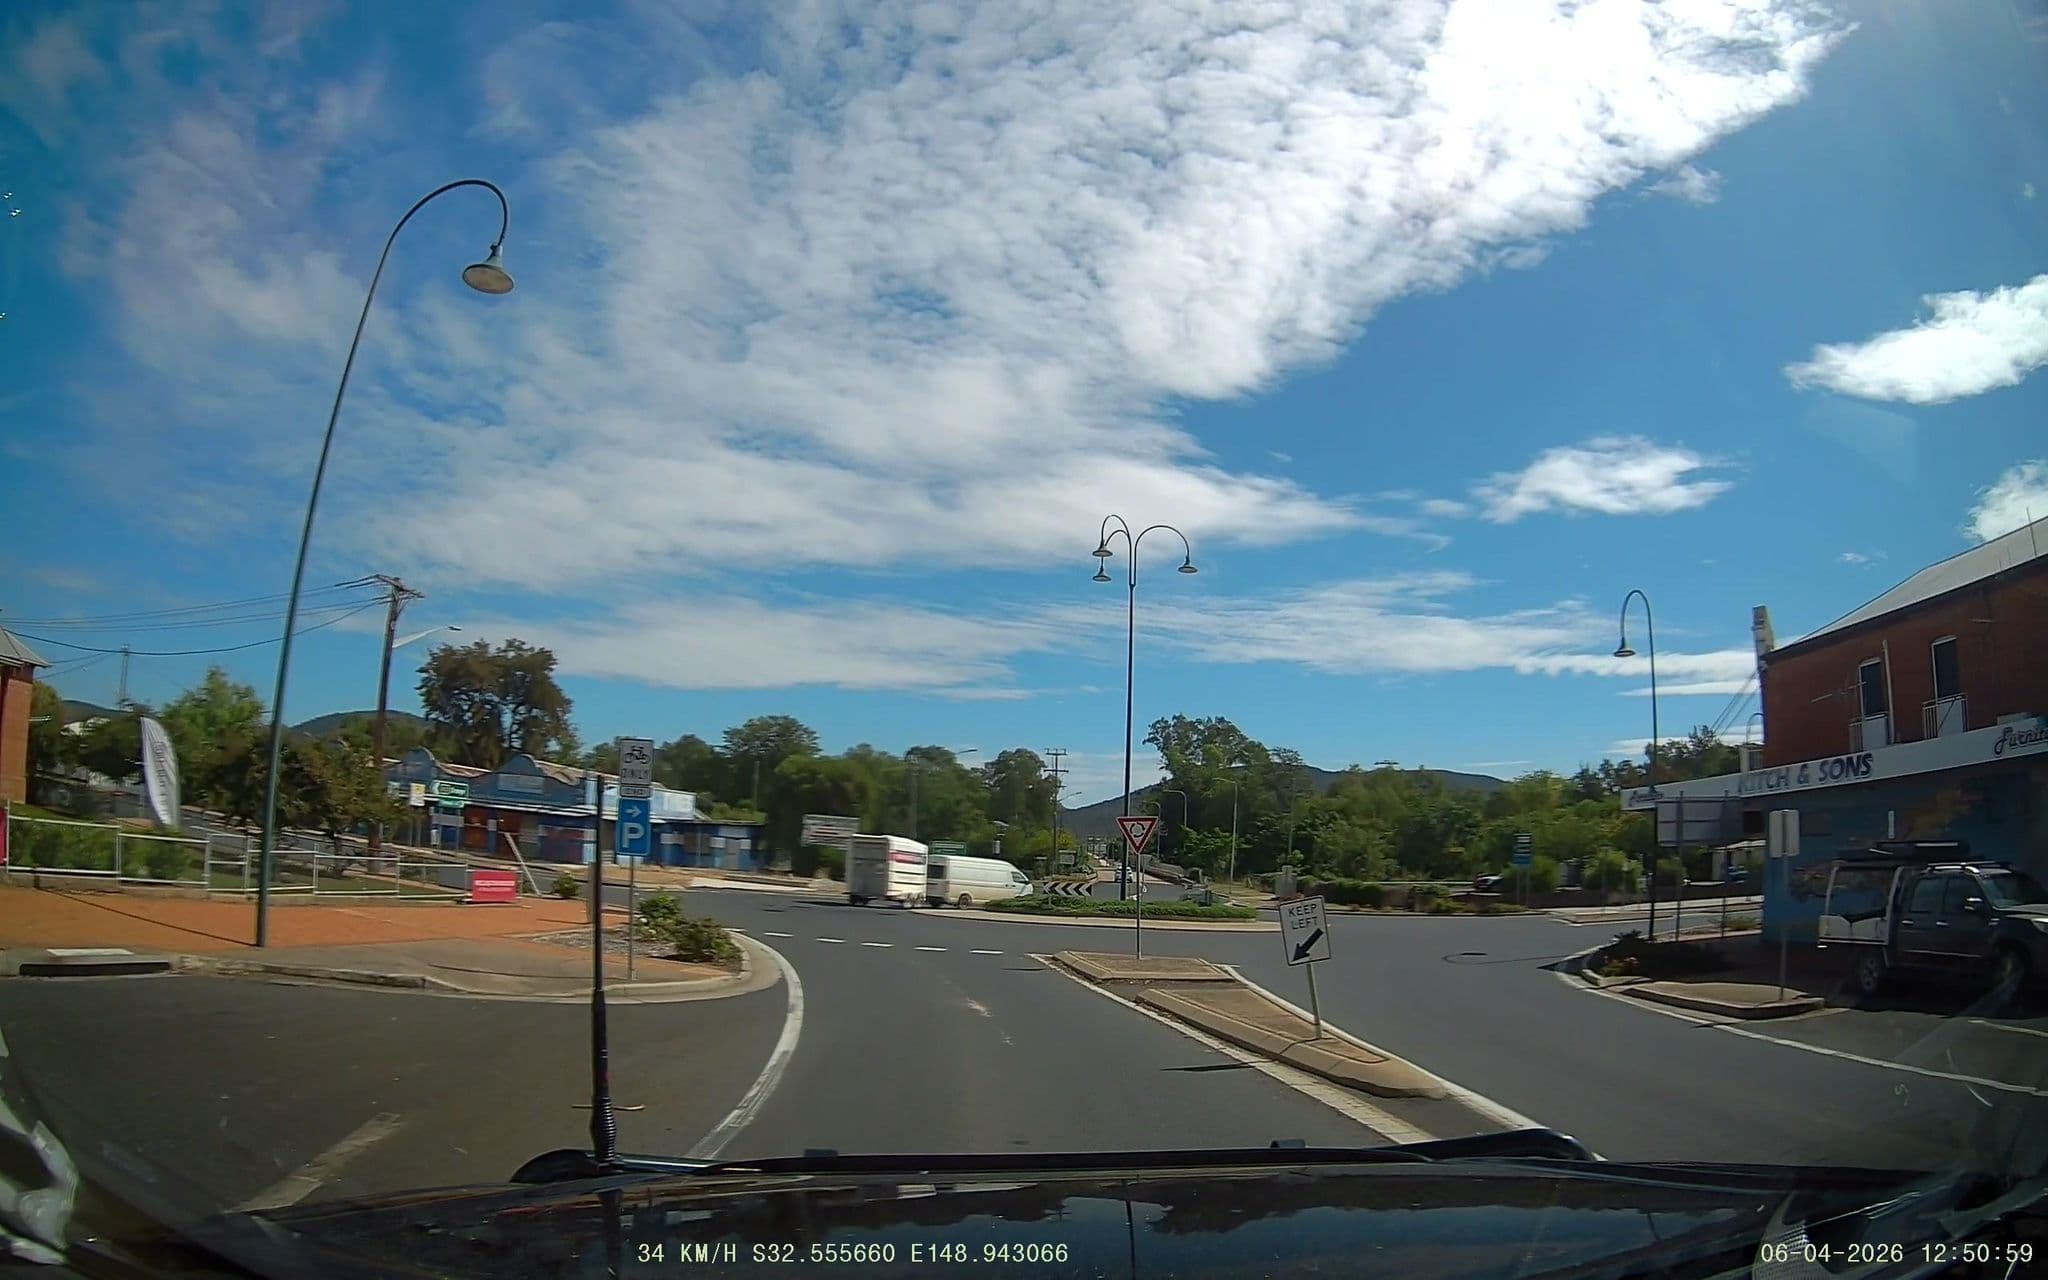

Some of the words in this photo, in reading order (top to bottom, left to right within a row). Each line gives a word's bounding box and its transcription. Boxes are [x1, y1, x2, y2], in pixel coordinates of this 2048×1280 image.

[1797, 763, 1809, 785] &
[1818, 752, 1874, 782] SONS
[622, 822, 645, 848] P
[1288, 903, 1317, 917] KEEP
[1291, 916, 1318, 929] LEFT
